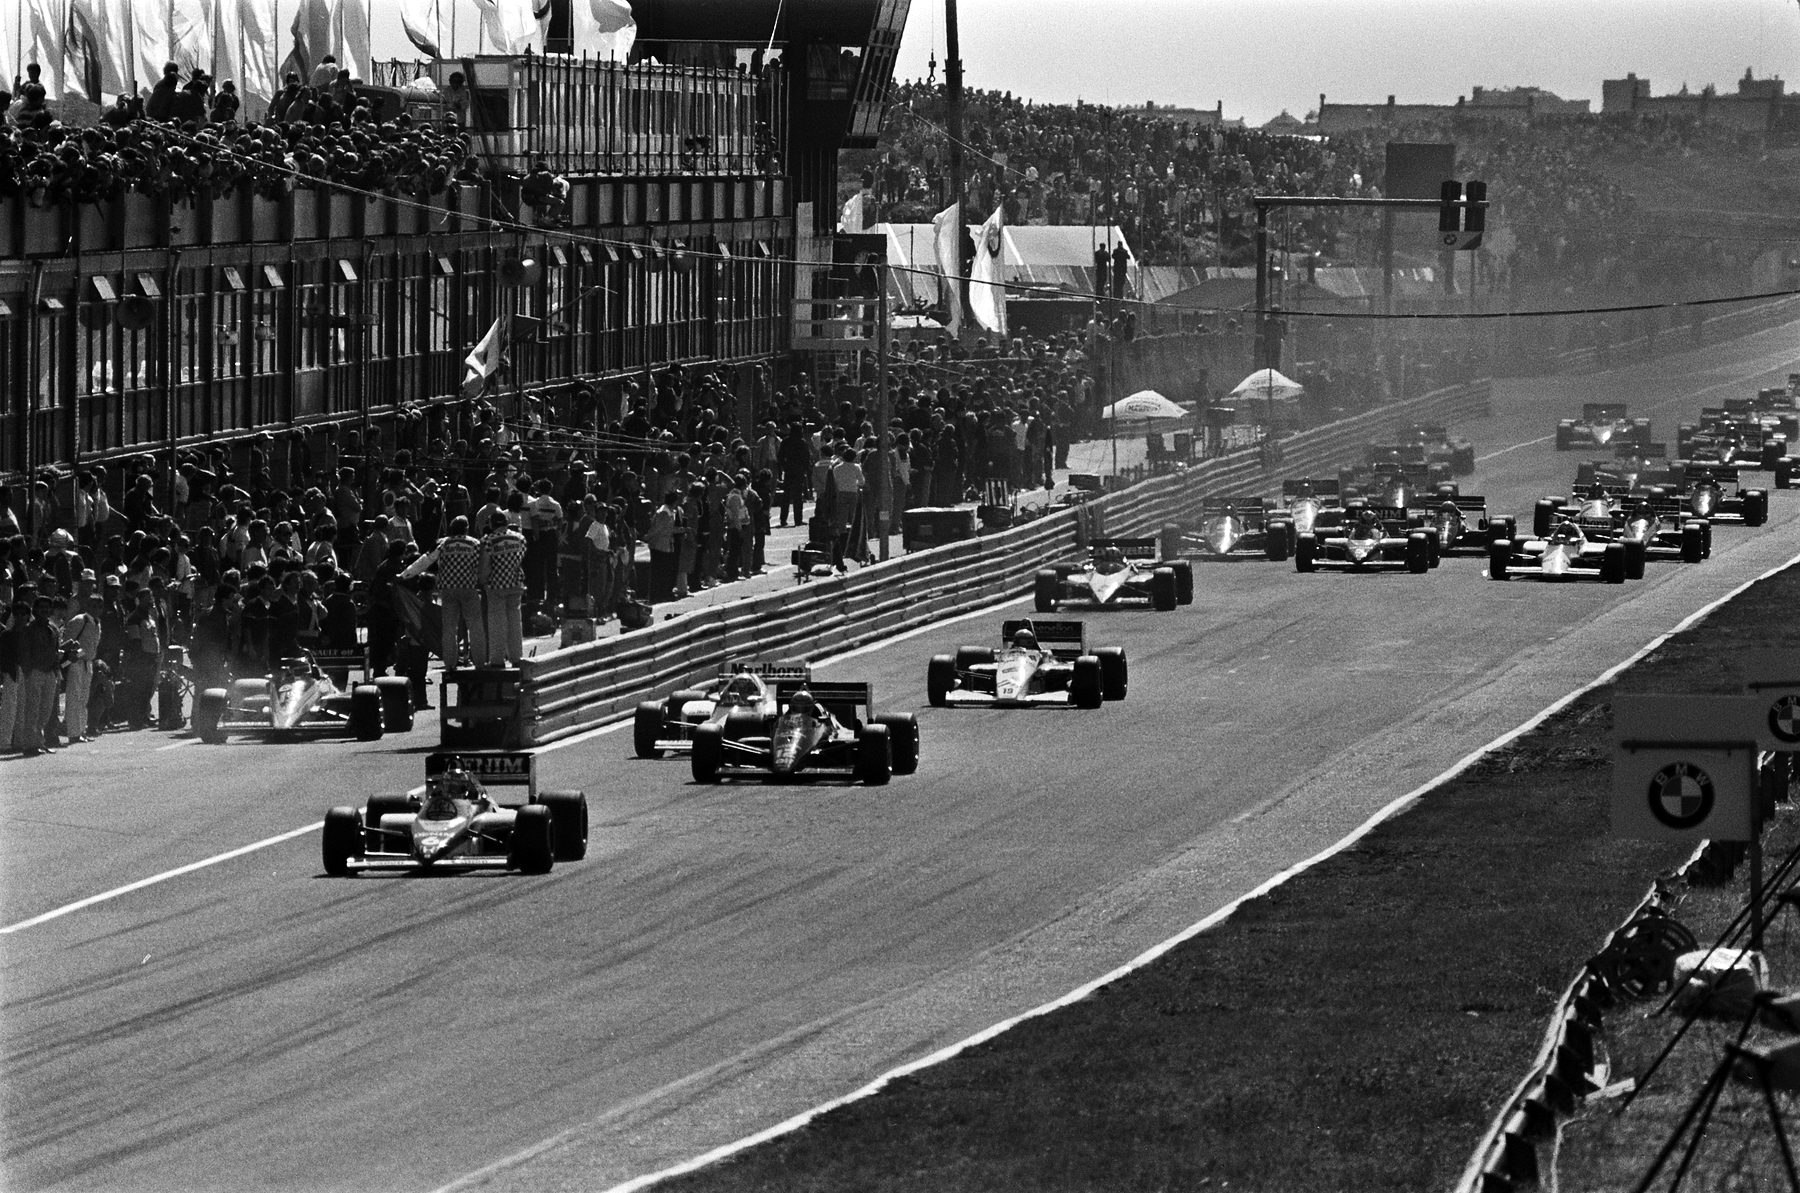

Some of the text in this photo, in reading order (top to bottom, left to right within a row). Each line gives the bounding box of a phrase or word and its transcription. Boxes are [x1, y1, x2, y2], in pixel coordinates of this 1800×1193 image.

[1355, 509, 1402, 518] DNIM
[731, 662, 804, 678] Marlboro
[1002, 687, 1014, 695] 19
[1654, 763, 1710, 787] BMW
